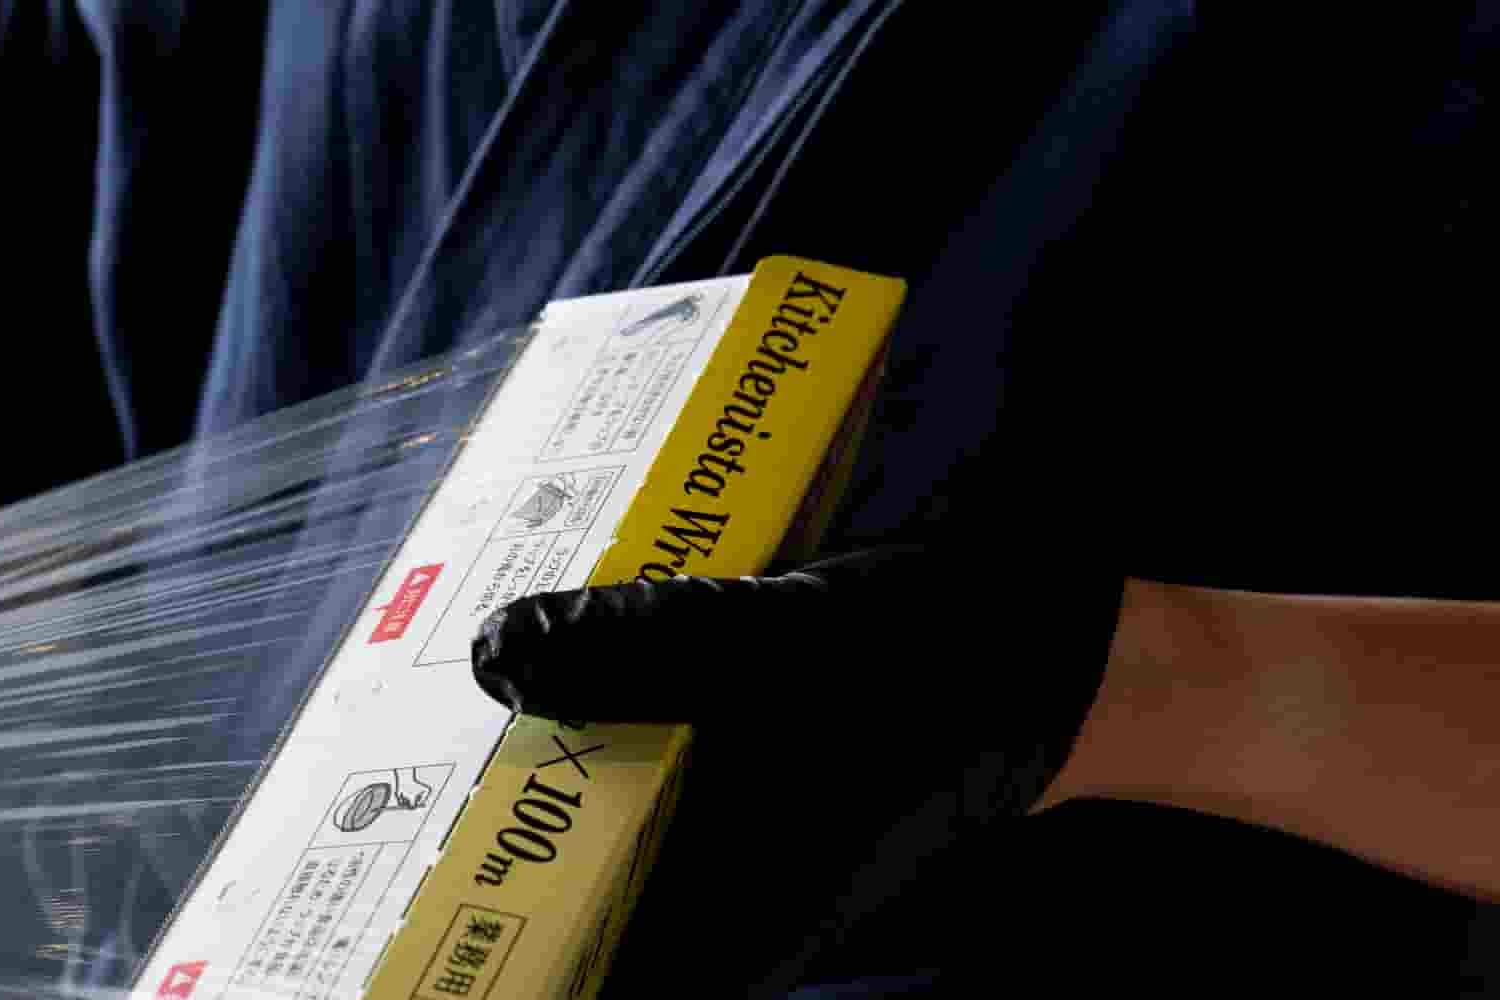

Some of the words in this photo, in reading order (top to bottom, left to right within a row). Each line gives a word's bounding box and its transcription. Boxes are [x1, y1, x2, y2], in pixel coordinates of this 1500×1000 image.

[684, 272, 848, 497] Kitchenista
[635, 506, 731, 585] Wra
[474, 719, 604, 886] ×100m
[434, 912, 505, 997] 業務用
